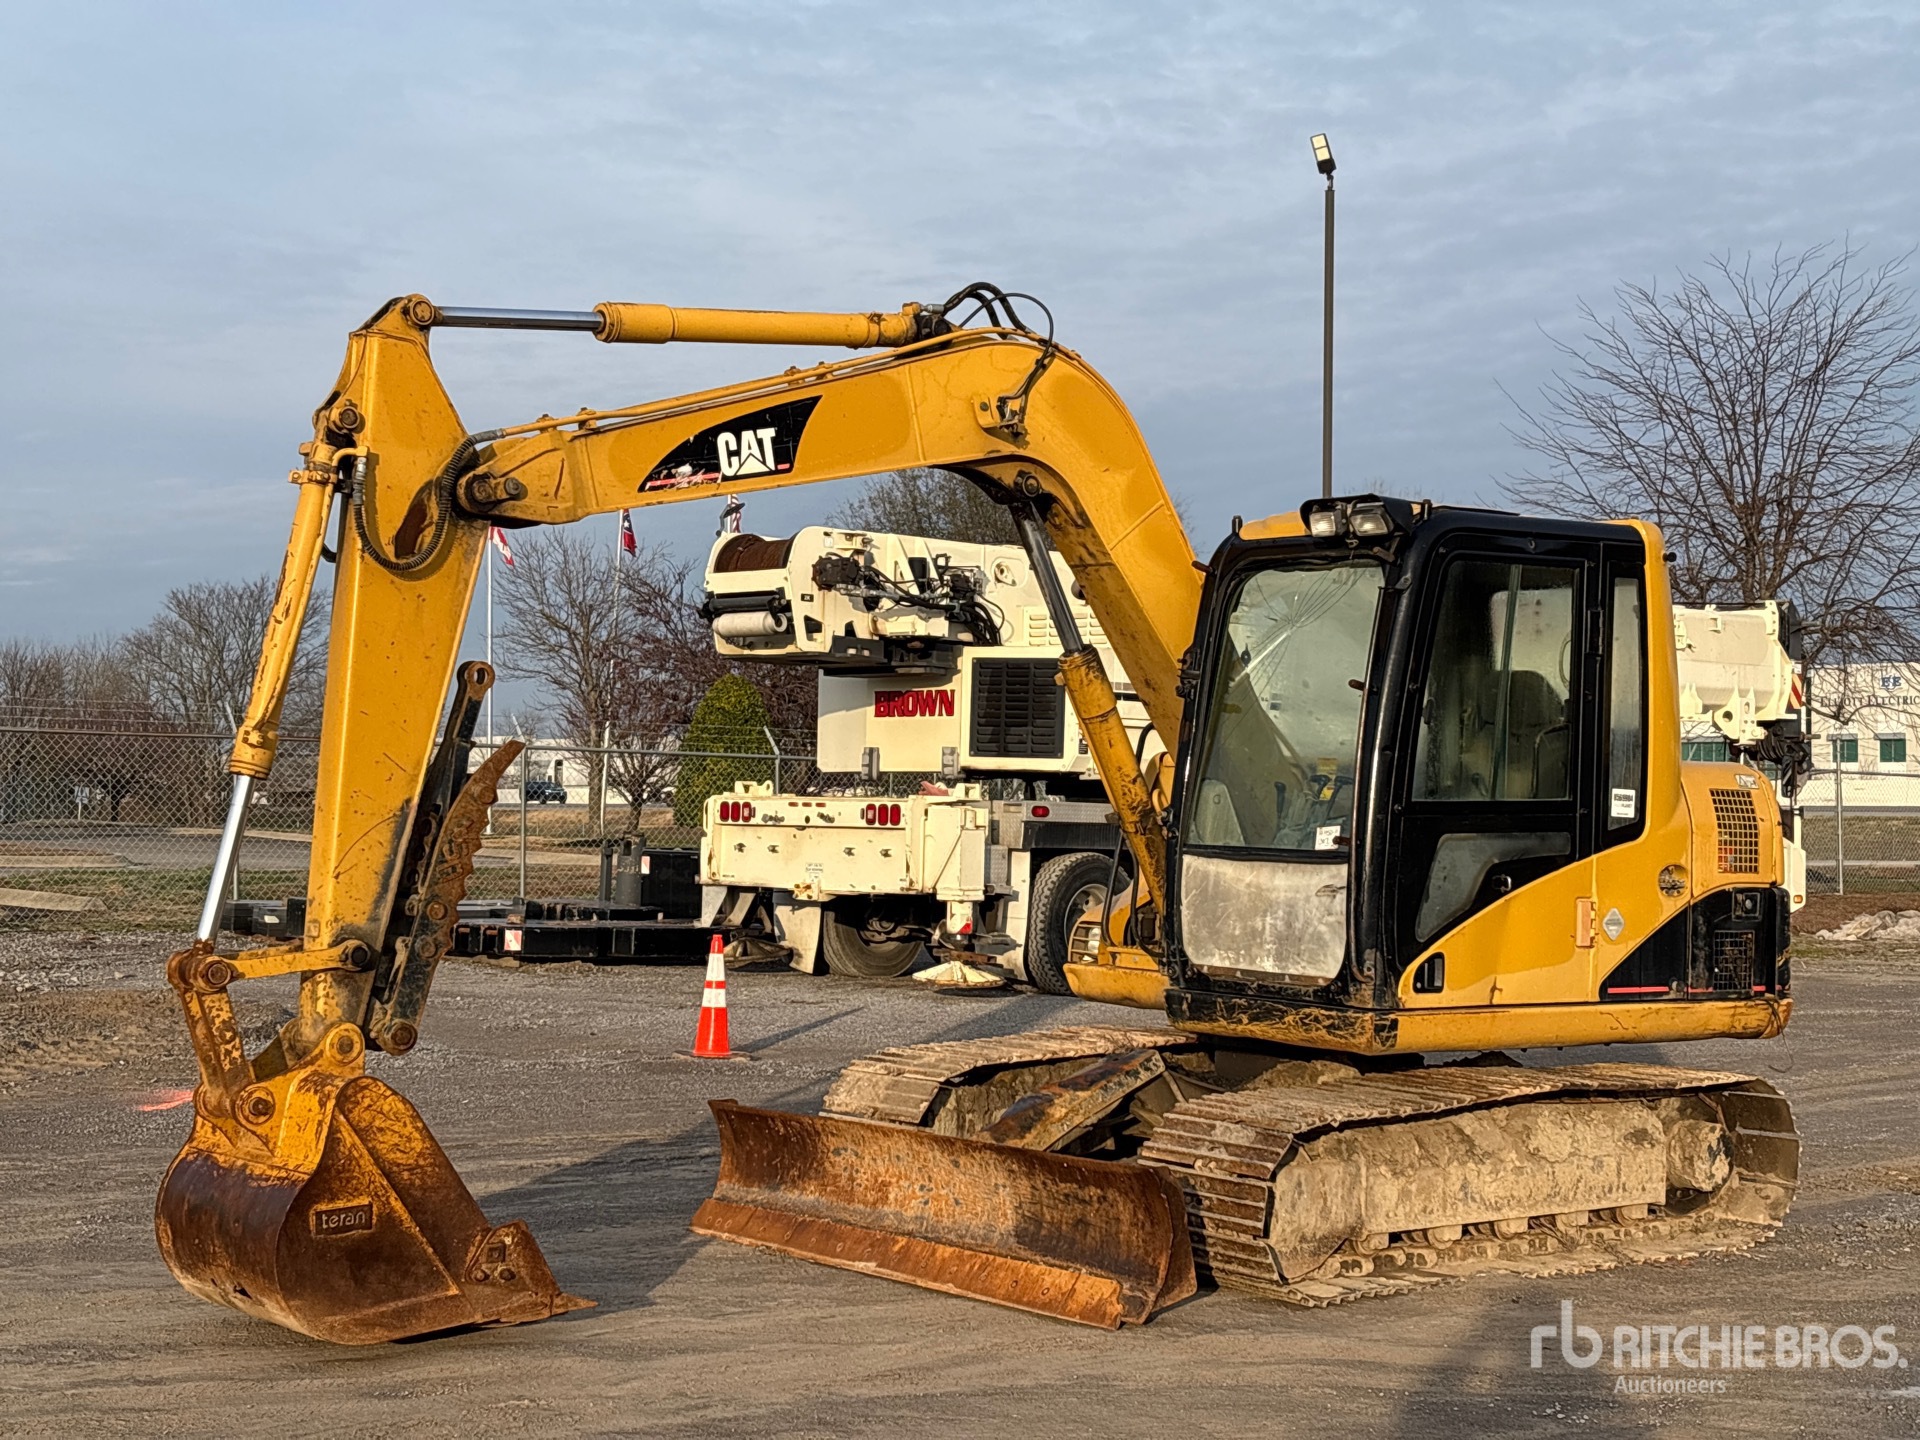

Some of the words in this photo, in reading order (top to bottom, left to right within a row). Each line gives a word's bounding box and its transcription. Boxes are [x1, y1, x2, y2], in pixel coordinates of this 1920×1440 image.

[717, 427, 776, 477] CAT
[874, 689, 956, 718] BROWN
[1820, 696, 1863, 707] ELLOTT
[321, 1210, 366, 1229] teran
